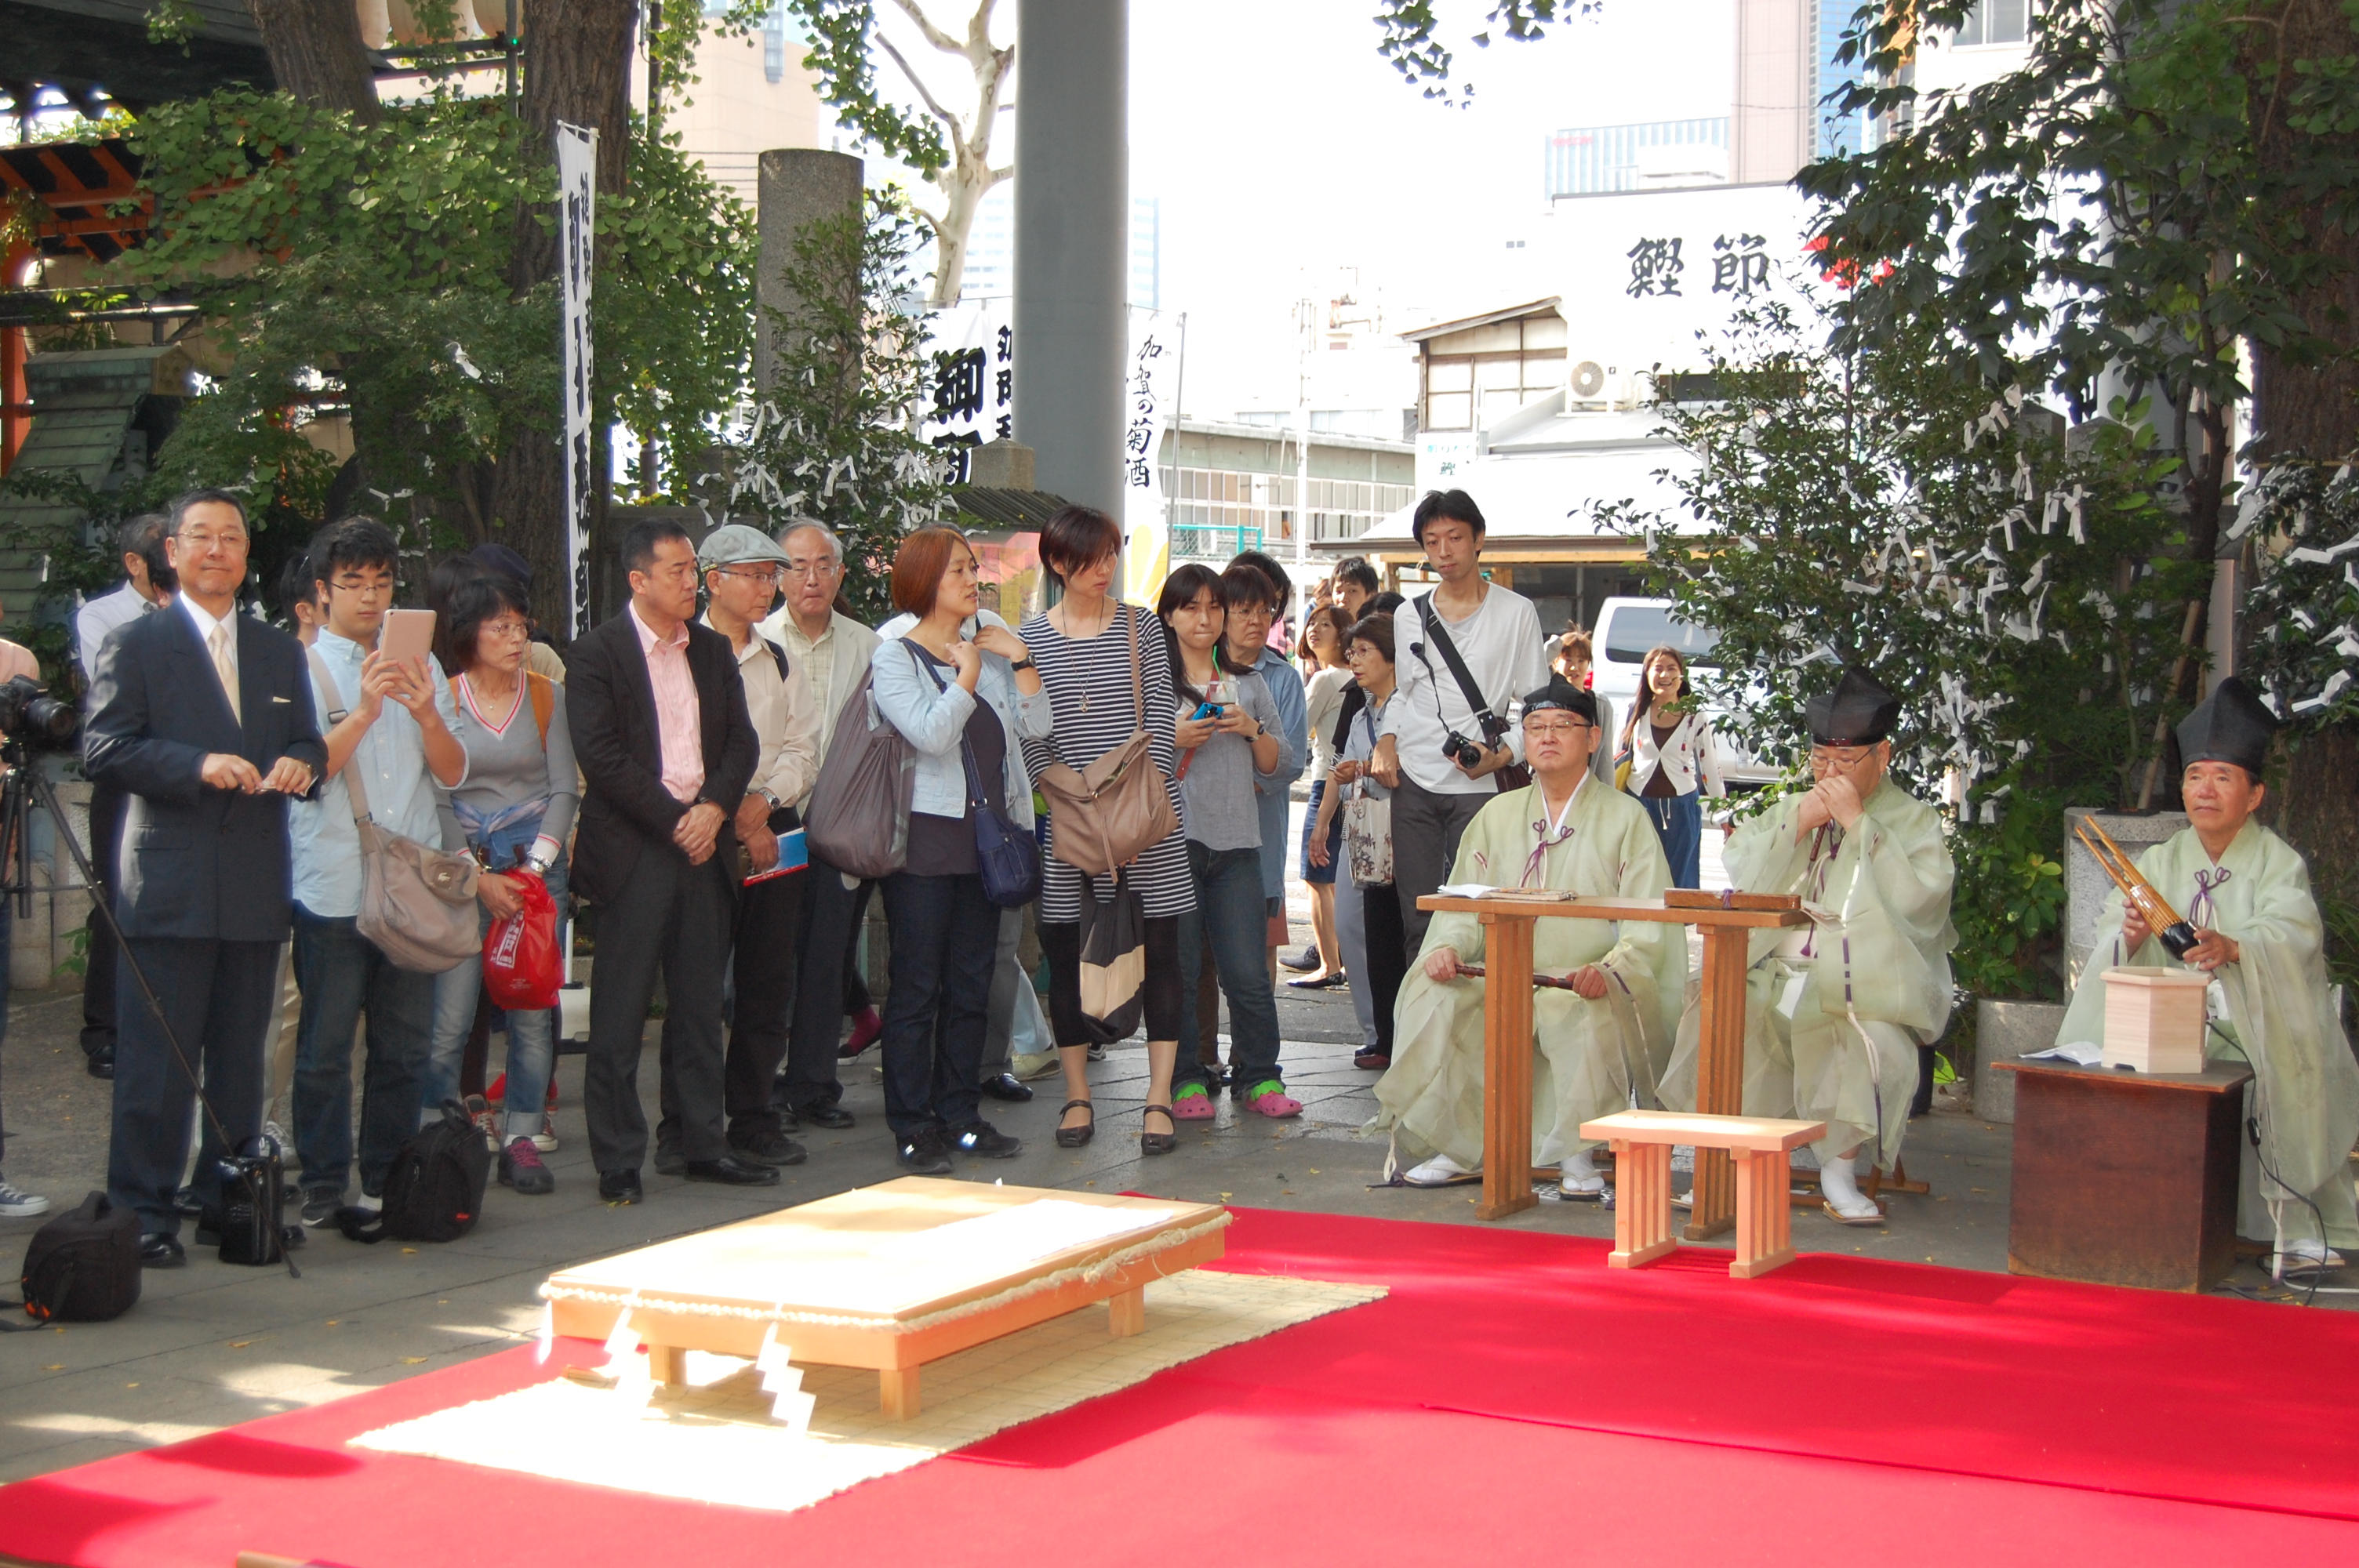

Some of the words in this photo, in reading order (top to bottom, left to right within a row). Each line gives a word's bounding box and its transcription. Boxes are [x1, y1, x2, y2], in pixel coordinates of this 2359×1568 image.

[1626, 233, 1770, 299] 鰹節
[1125, 334, 1162, 488] 加賀の菊酒
